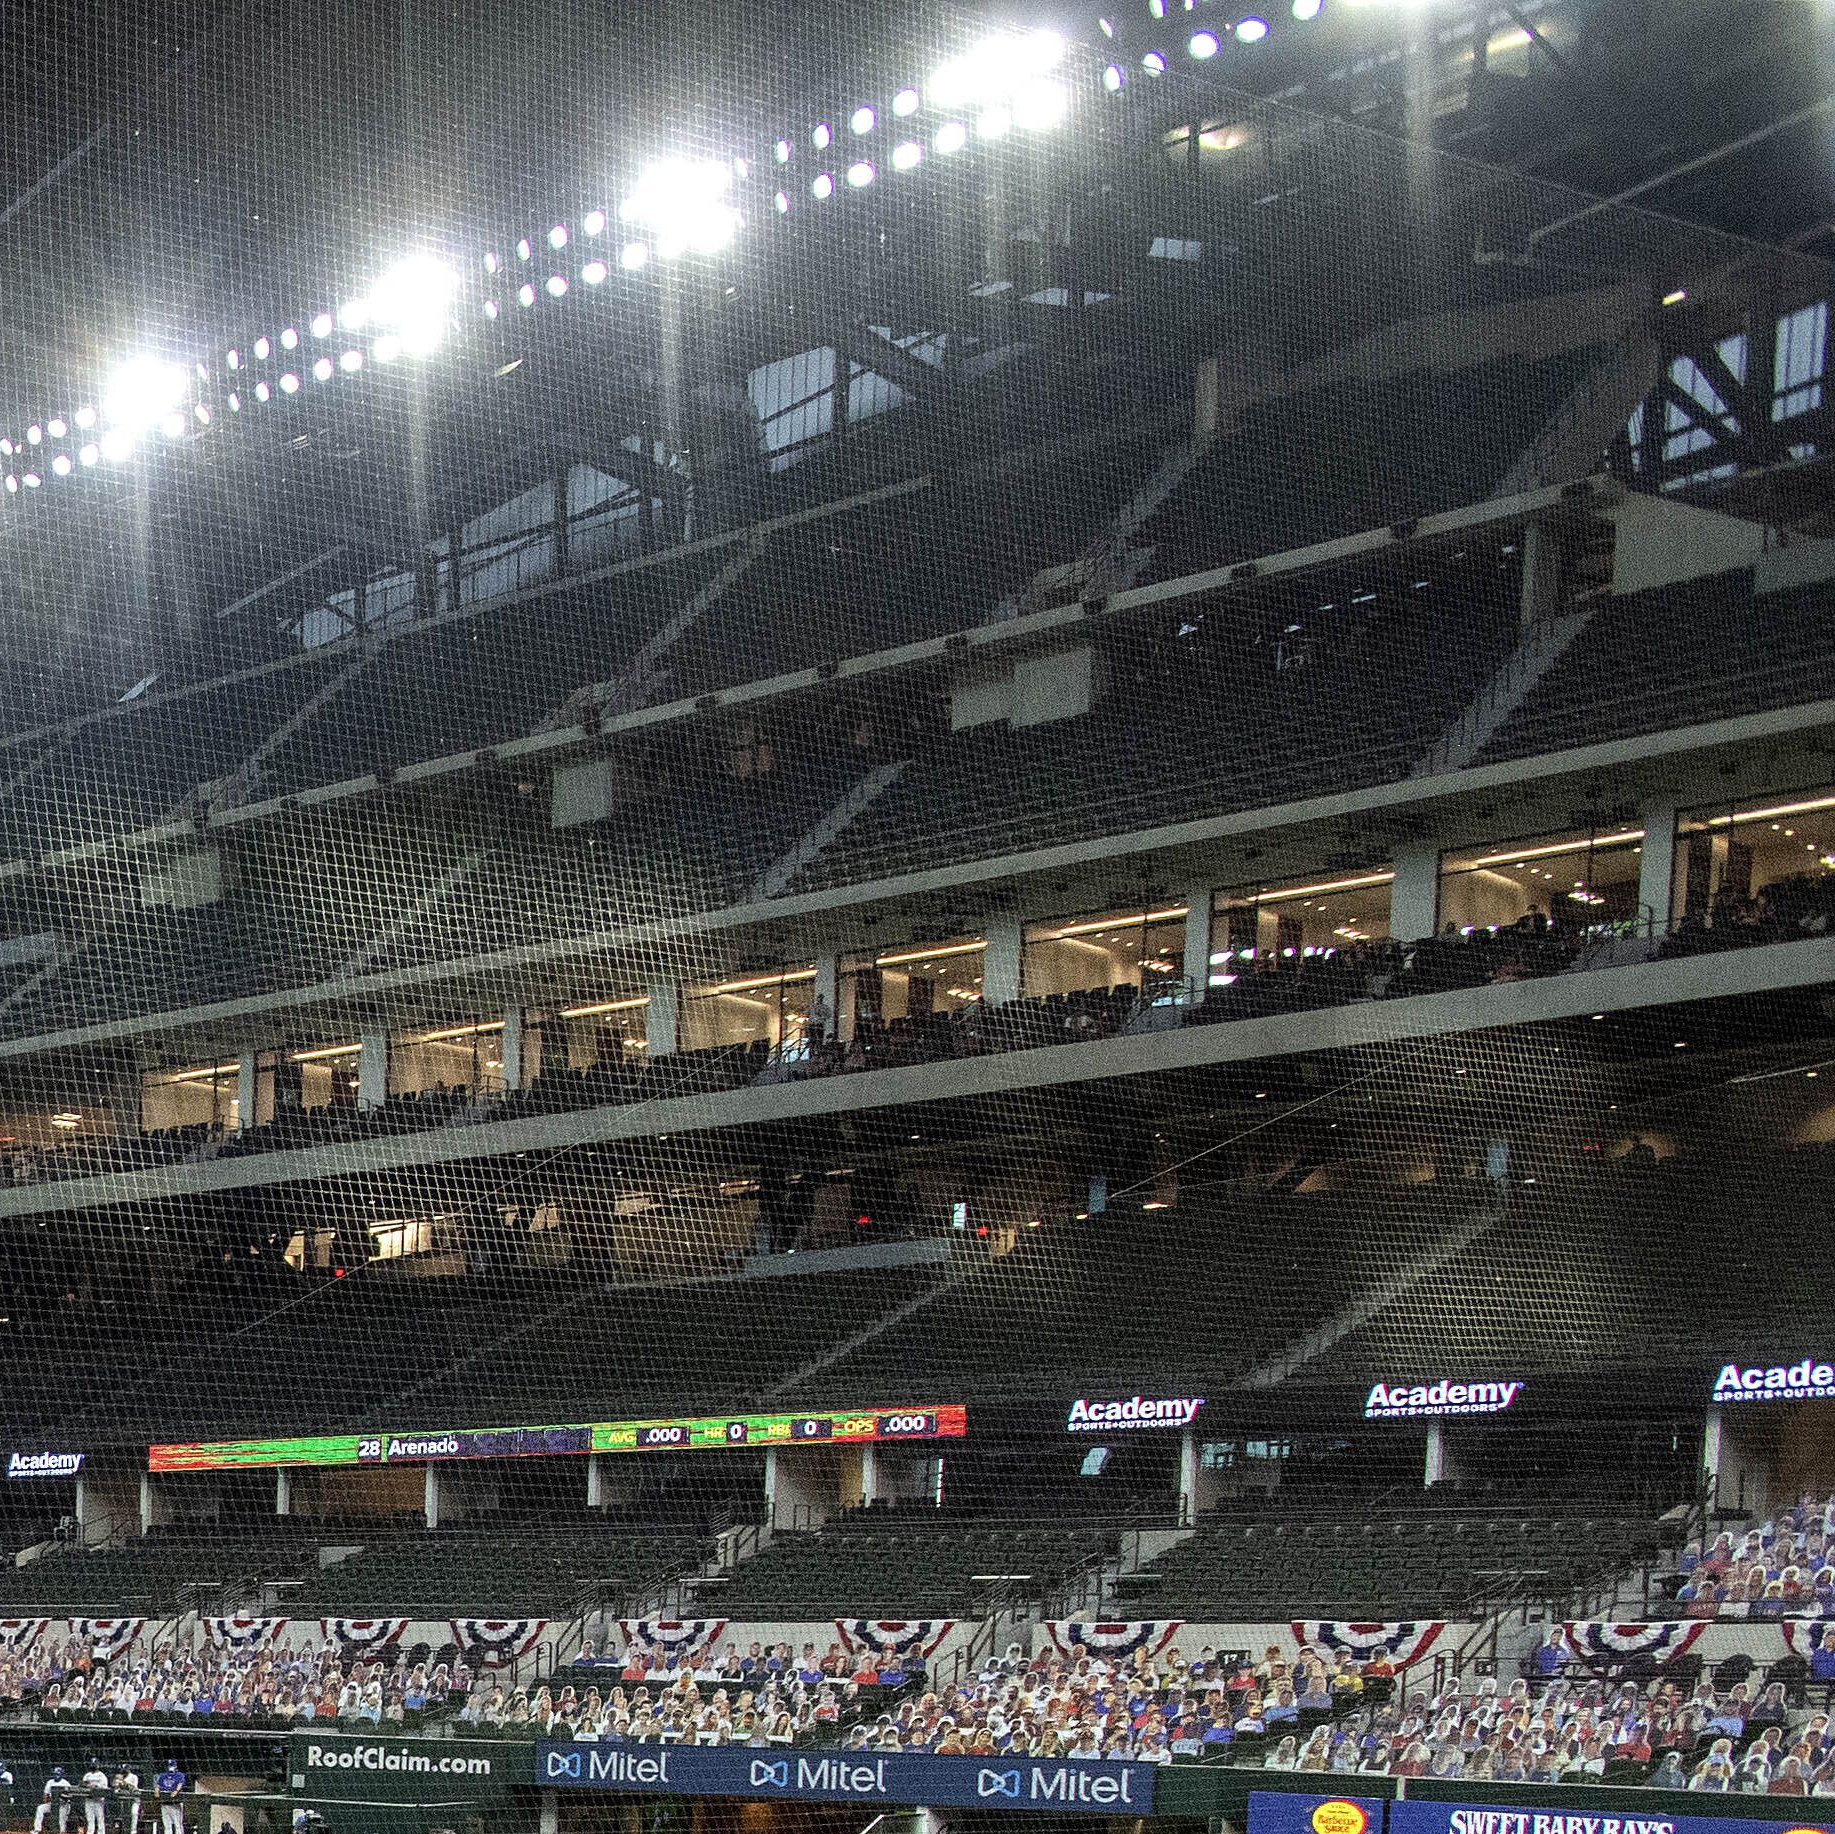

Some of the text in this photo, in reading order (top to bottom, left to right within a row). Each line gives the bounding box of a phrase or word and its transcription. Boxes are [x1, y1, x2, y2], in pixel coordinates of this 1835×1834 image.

[1070, 1396, 1199, 1422] Academy
[1367, 1379, 1517, 1409] Academy
[1067, 1418, 1182, 1431] SPORTS+OUTDOORS
[1364, 1402, 1499, 1418] SPORTS+OUTDOORS
[359, 1415, 926, 1457] 28 Arenado AVG .000 HR OPS .000
[11, 1452, 81, 1475] Academy
[307, 1745, 491, 1775] RoofClaim.com
[589, 1750, 669, 1783] Mitel
[794, 1758, 884, 1793] Mitel
[1027, 1767, 1129, 1803] Mitel
